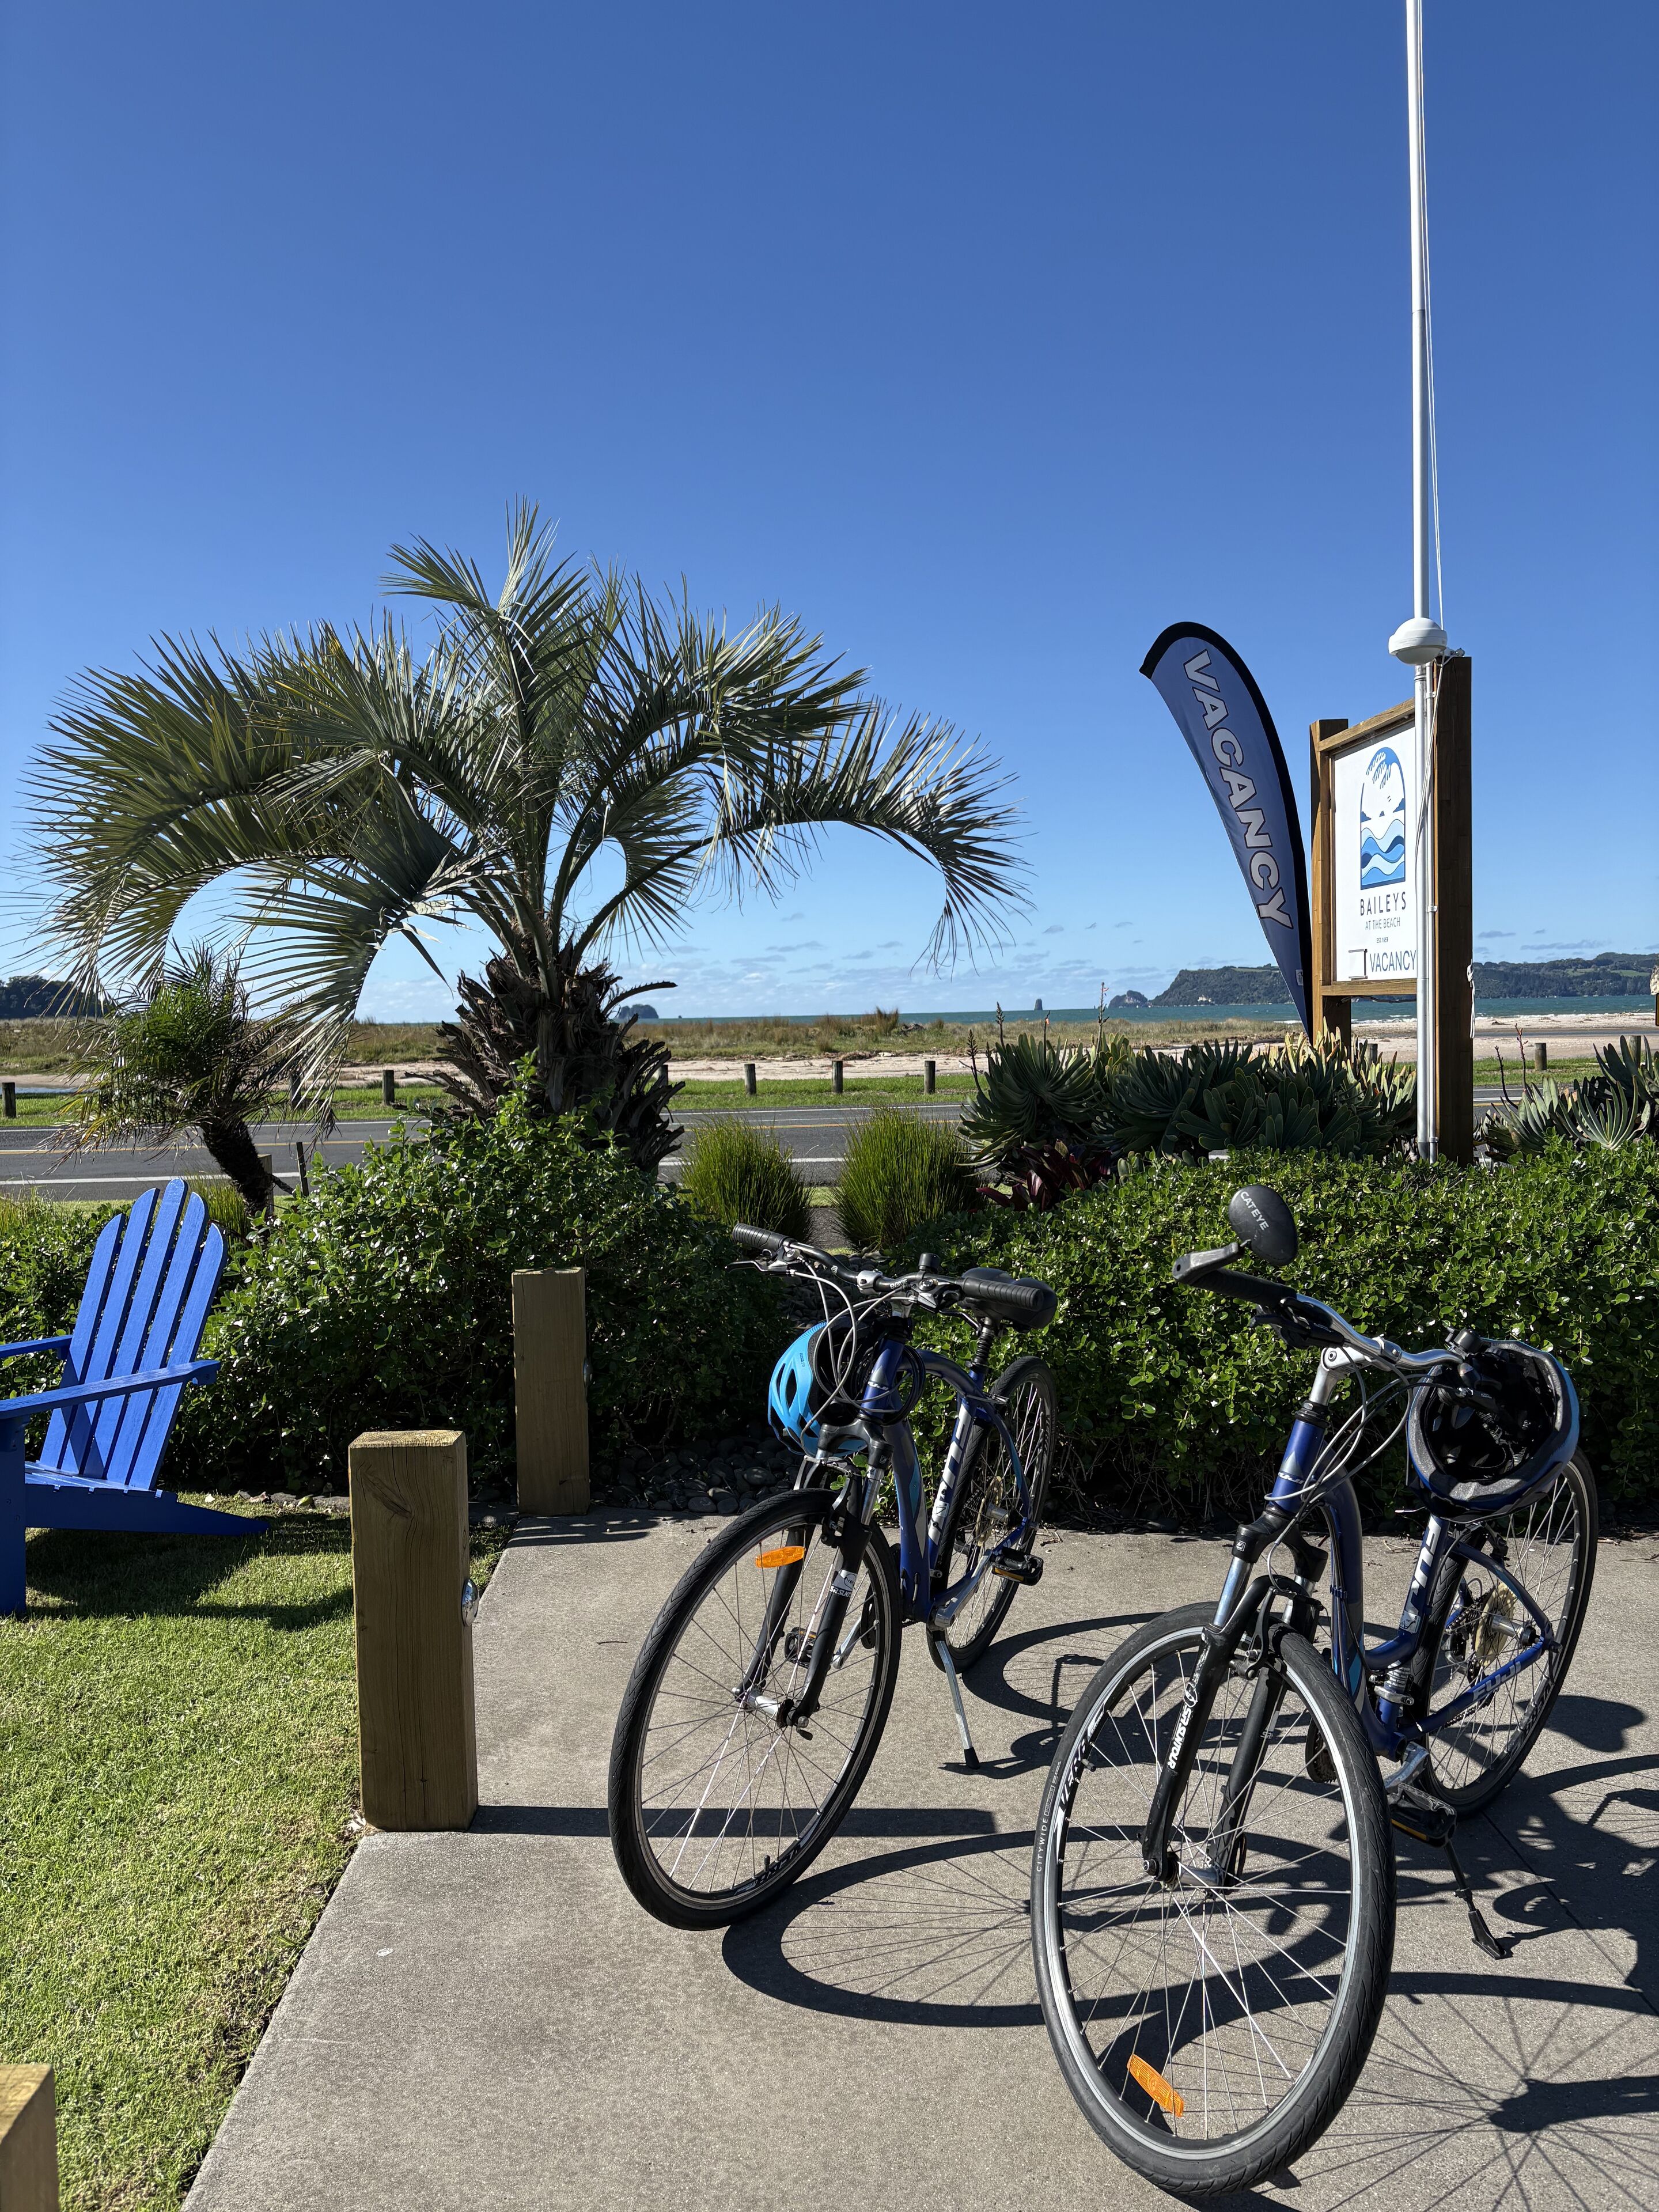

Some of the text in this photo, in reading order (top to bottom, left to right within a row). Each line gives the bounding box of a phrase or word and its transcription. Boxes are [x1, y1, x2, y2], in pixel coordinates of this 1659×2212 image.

[1183, 648, 1294, 930] VACANCY
[1360, 891, 1406, 916] BAILEYS
[1365, 916, 1400, 930] AT THE BEACH
[1370, 949, 1416, 972] VACANCY
[1240, 1191, 1270, 1230] CATEYE
[1404, 1515, 1442, 1616] FUJ
[1472, 1661, 1521, 1702] FUJI
[1180, 1705, 1192, 1726] SR
[1167, 1723, 1187, 1770] SUNTOUR
[1036, 1817, 1049, 1872] CITYWIDE
